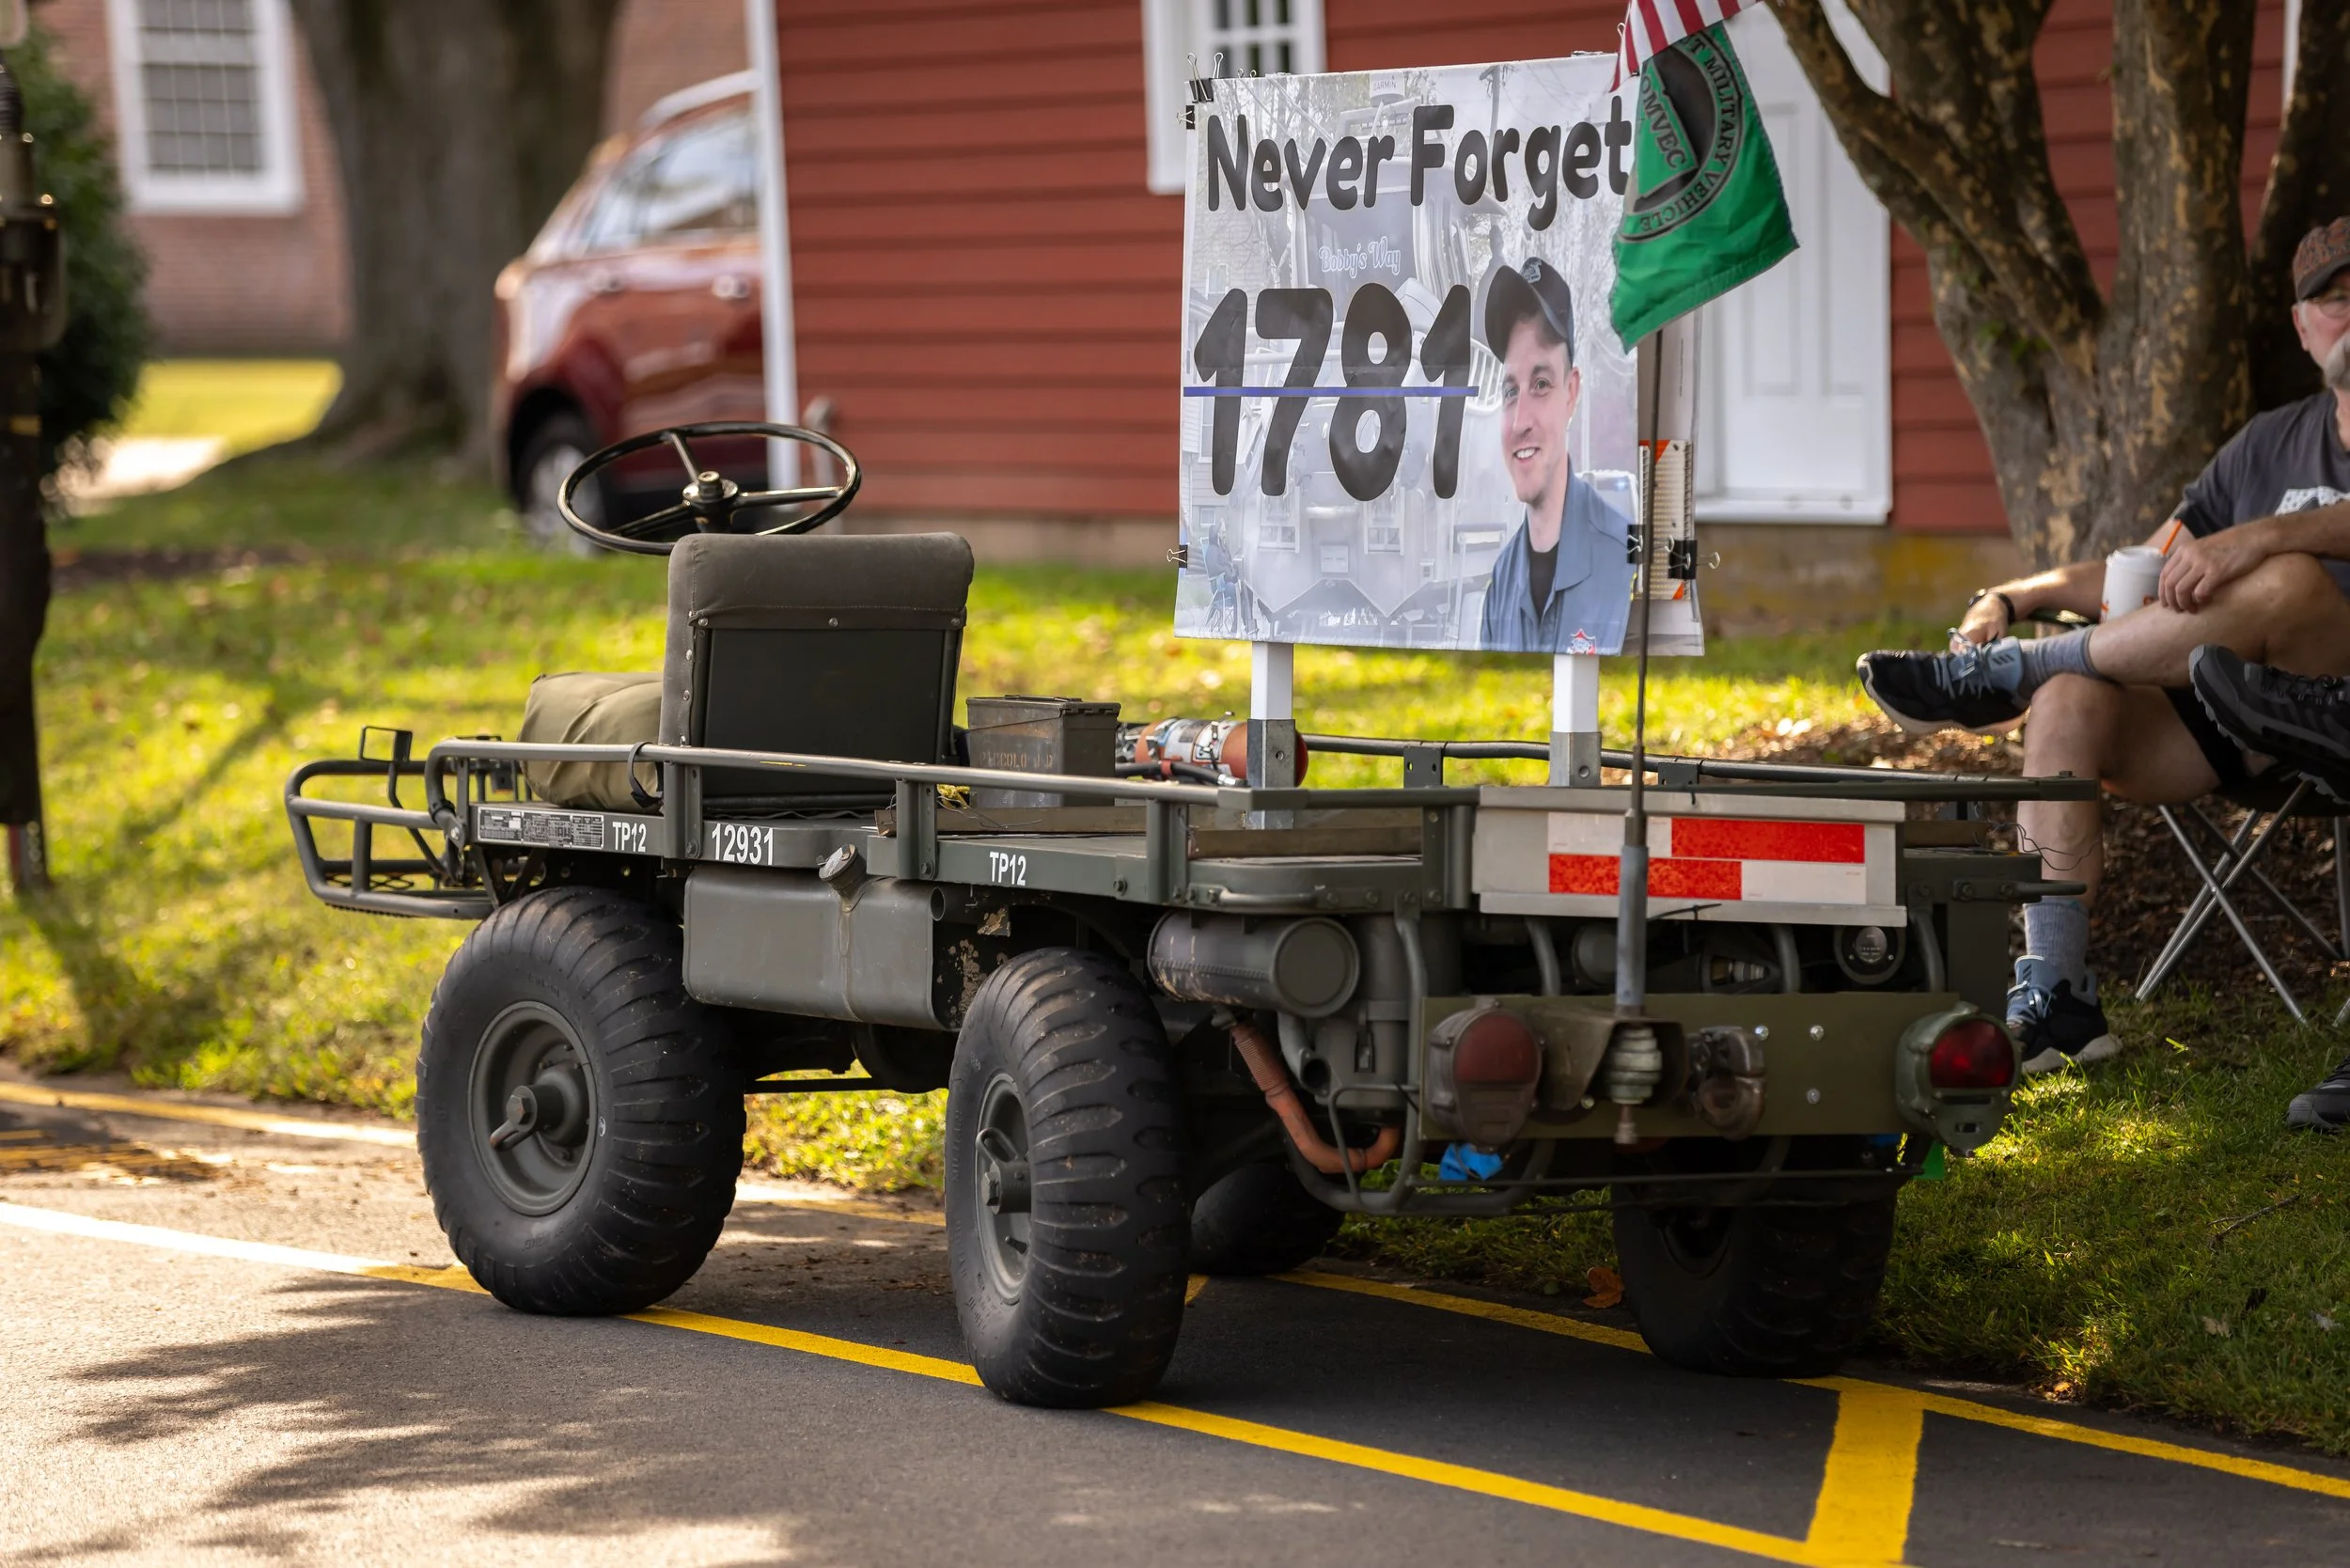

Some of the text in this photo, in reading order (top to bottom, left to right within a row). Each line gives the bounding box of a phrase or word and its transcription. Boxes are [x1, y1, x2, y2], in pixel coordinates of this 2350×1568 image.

[1704, 56, 1735, 168] MILITARY
[1207, 95, 1632, 231] Never Forget
[1640, 172, 1723, 231] VEHICLE
[1318, 235, 1402, 279] Bobby's Way
[1194, 282, 1472, 502] 1781
[612, 821, 648, 854] TP12
[712, 823, 774, 866] 12931
[989, 851, 1026, 886] TP12
